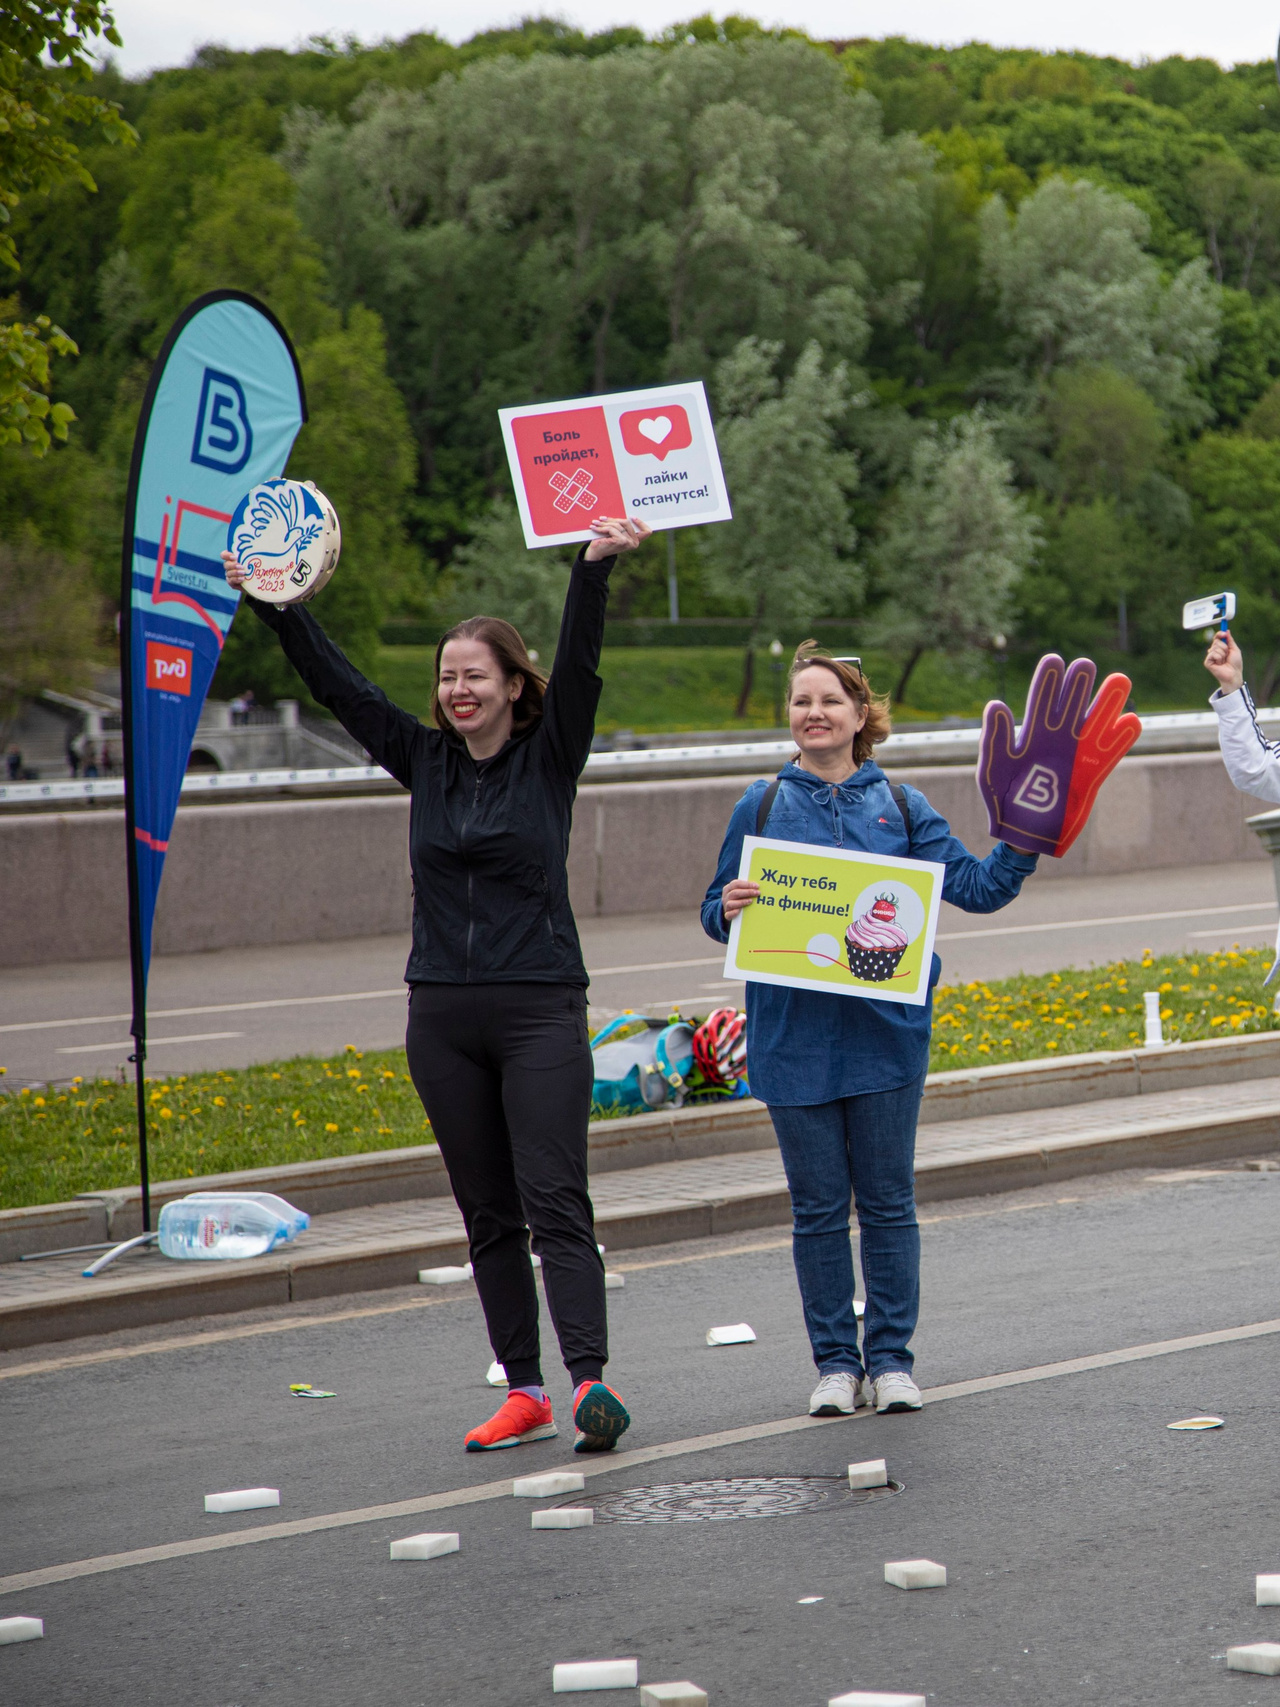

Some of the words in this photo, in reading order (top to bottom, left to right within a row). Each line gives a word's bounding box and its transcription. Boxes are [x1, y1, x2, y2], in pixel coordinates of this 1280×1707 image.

[542, 429, 581, 444] Боль
[533, 447, 599, 467] пройдет,
[644, 470, 689, 486] лайки
[632, 485, 709, 507] останутся!
[167, 566, 208, 590] 5verst.ru
[257, 578, 285, 592] 2023
[760, 867, 798, 889] Жду
[800, 875, 838, 892] тебя
[756, 894, 775, 907] на
[778, 894, 850, 918] финише!
